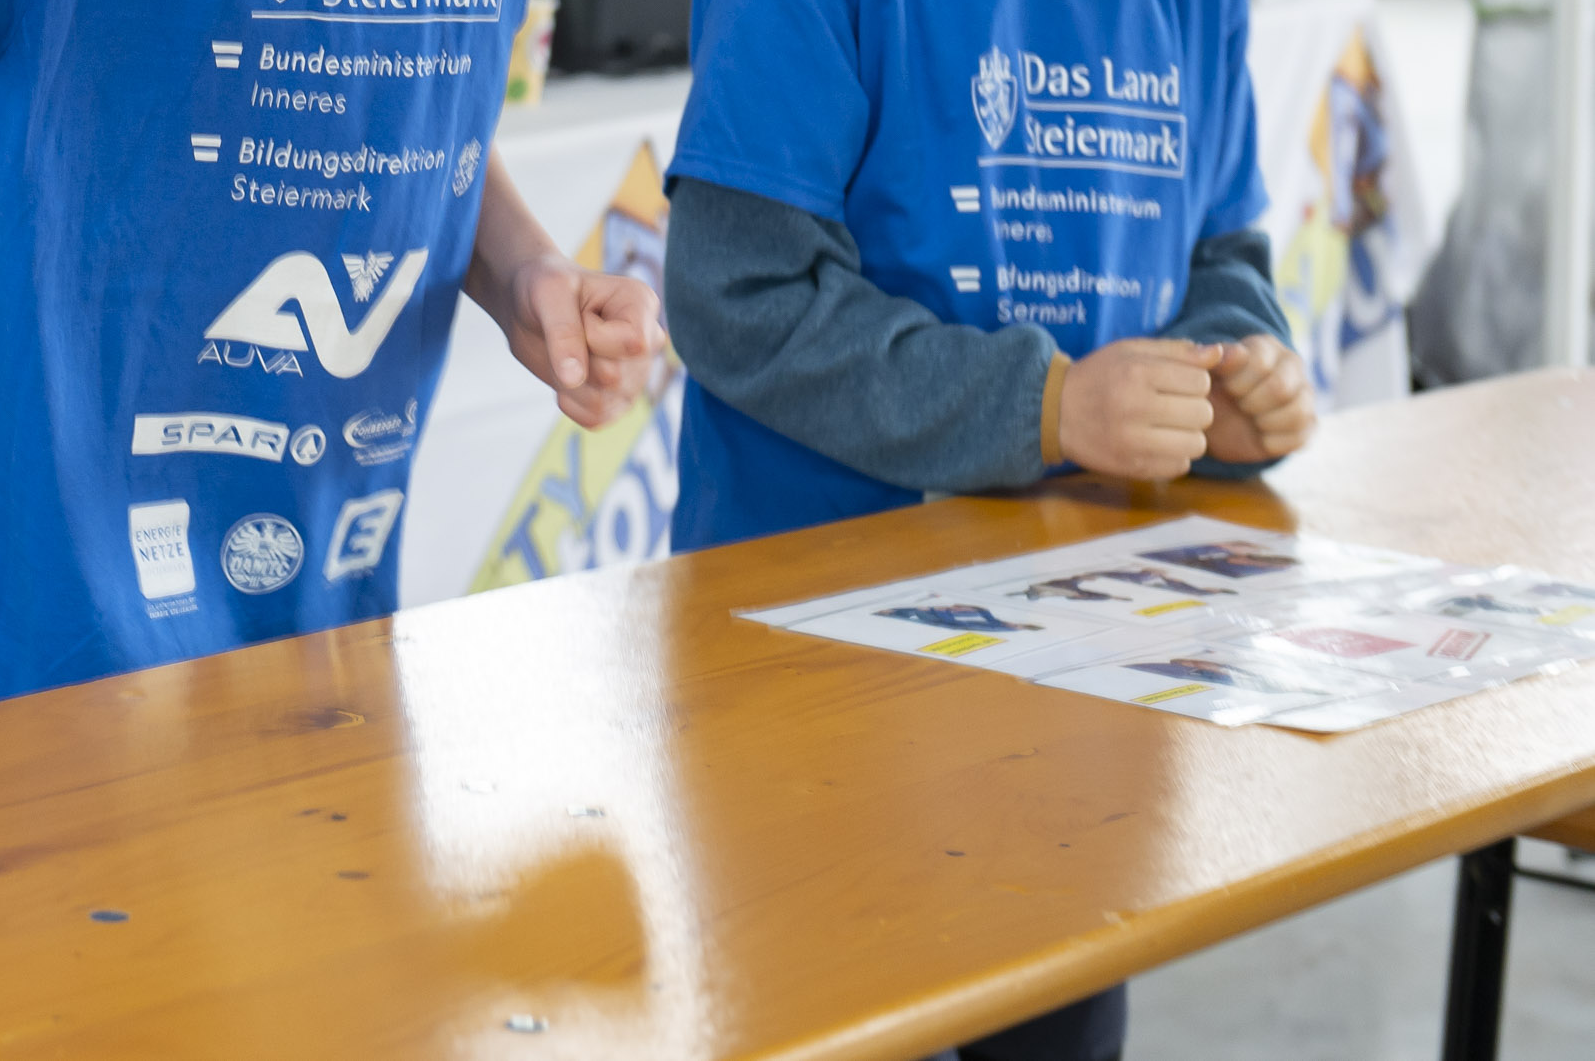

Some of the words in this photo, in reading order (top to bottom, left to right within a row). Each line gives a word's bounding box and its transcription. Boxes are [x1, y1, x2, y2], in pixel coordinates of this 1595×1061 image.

[259, 42, 472, 78] Bundesministerium
[251, 80, 346, 114] Inneres
[1023, 52, 1091, 97] Das
[1102, 56, 1180, 106] Land
[238, 135, 445, 180] Bildungsdirektion
[1024, 113, 1179, 166] Steiermark
[231, 172, 371, 213] Steiermark
[197, 340, 304, 379] AUVA
[161, 420, 282, 454] SPAR
[135, 524, 182, 543] ENERGIE
[138, 542, 185, 563] NETZE
